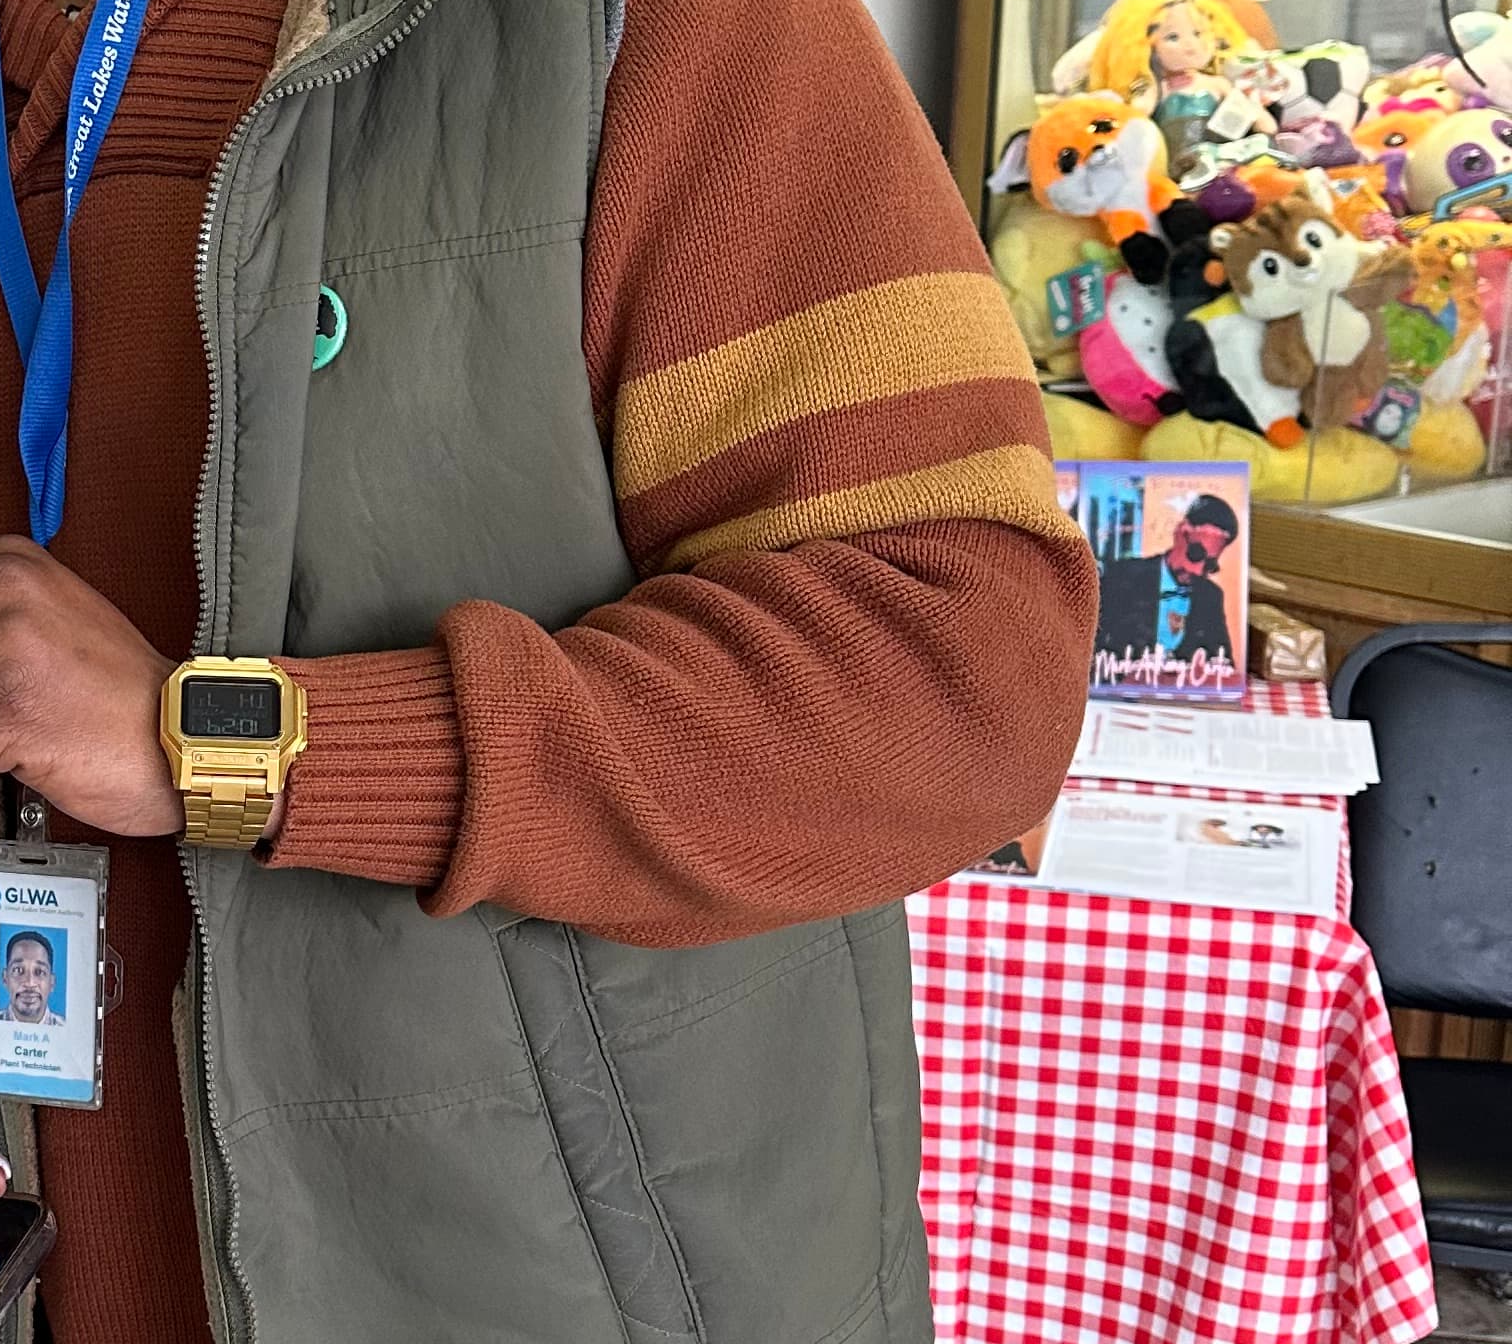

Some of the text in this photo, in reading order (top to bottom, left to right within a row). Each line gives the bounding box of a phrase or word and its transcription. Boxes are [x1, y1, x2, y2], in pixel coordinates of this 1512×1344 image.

[67, 114, 93, 180] Great
[83, 46, 117, 115] Lakes
[5, 887, 59, 907] GLWA
[14, 1030, 39, 1042] Mark
[14, 1046, 48, 1058] Carter
